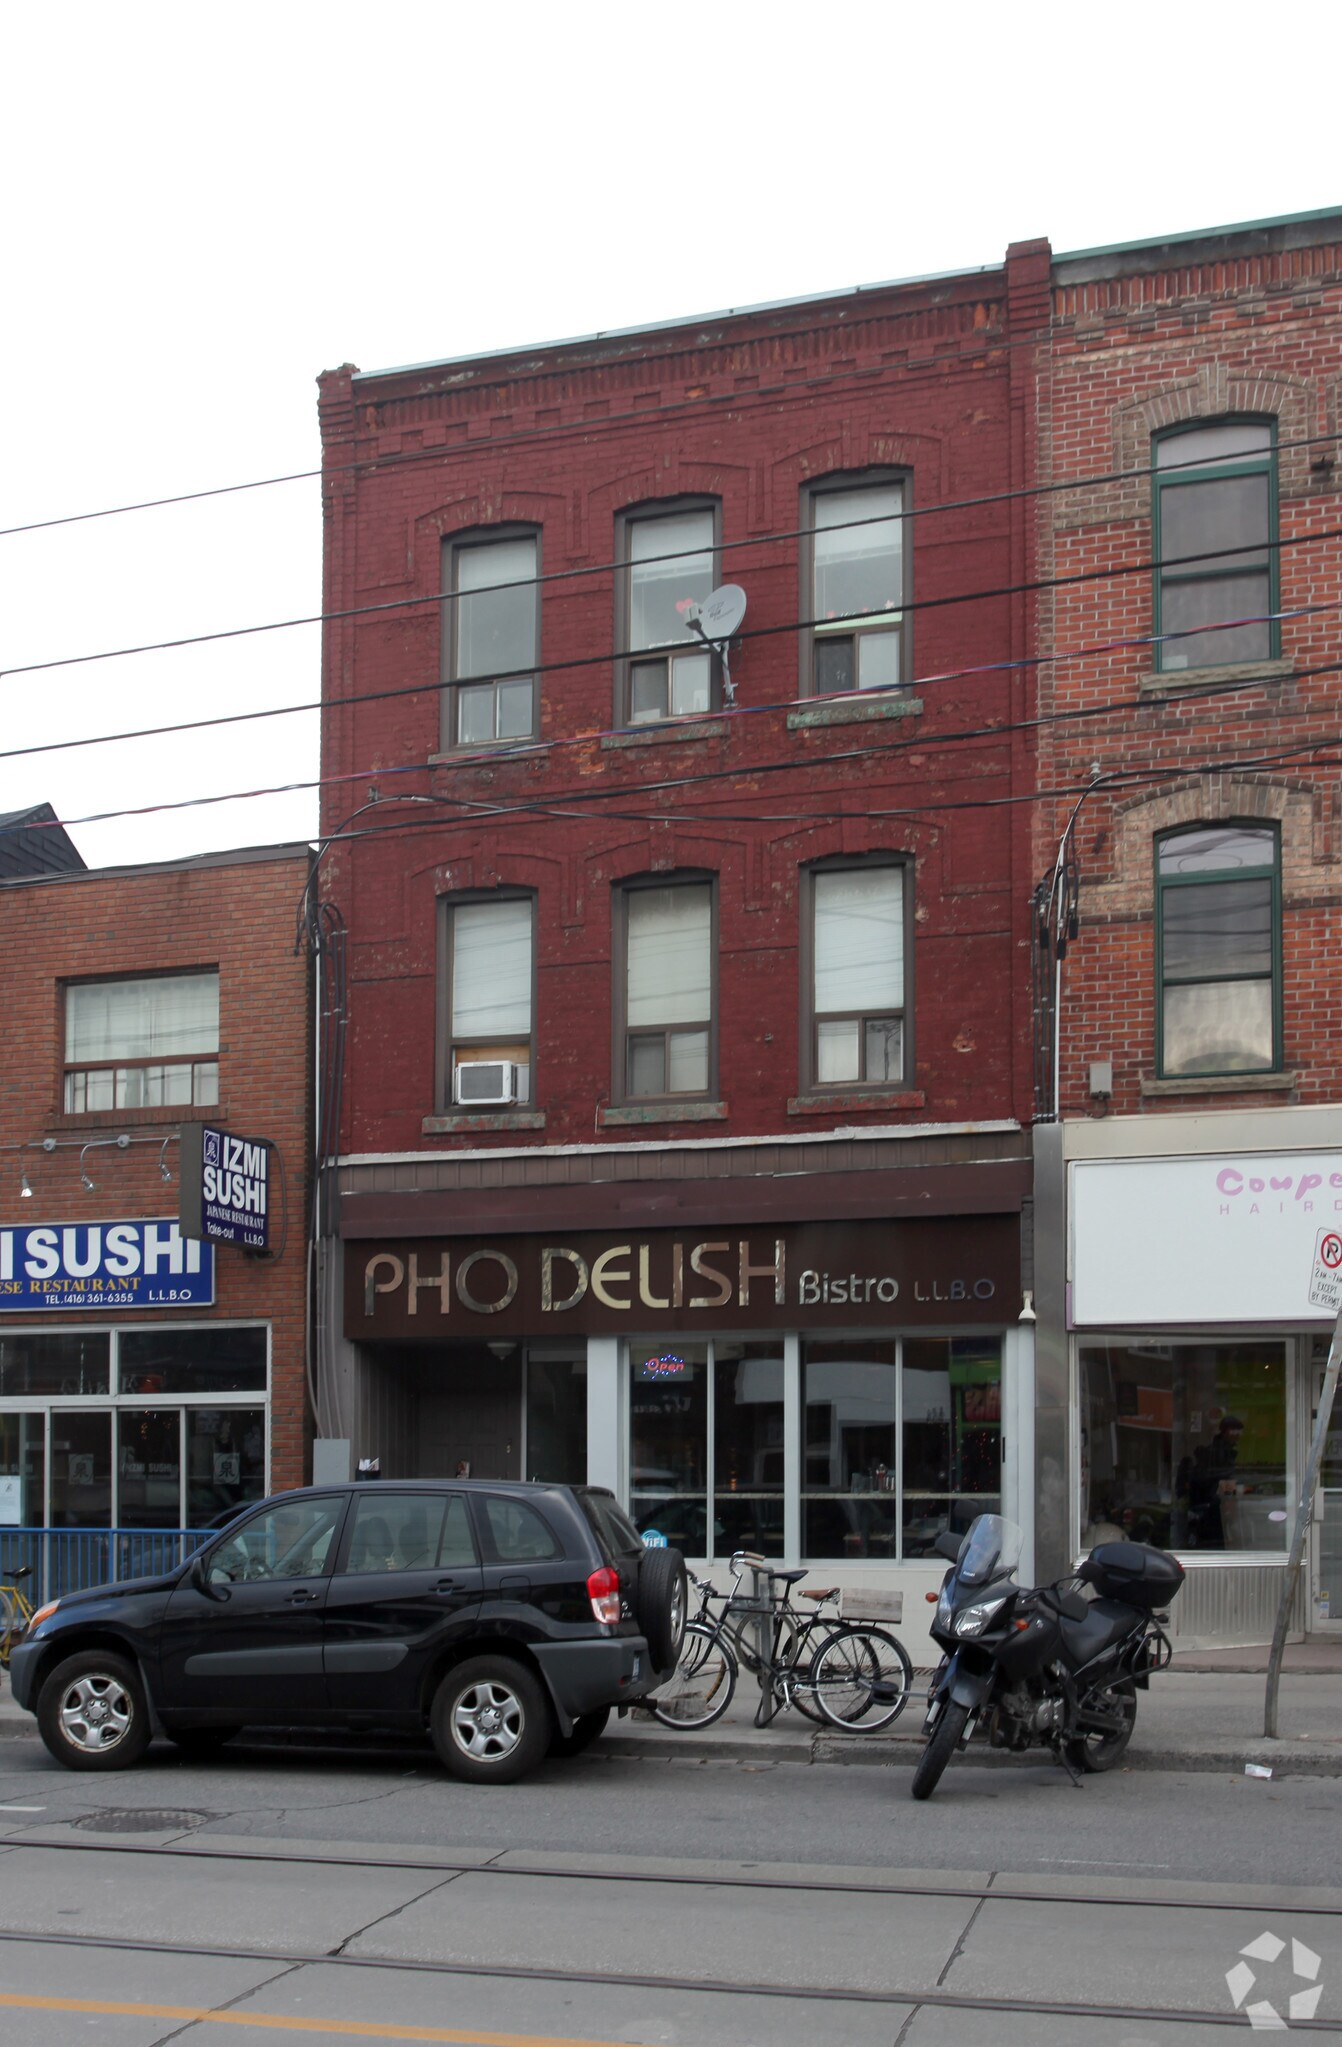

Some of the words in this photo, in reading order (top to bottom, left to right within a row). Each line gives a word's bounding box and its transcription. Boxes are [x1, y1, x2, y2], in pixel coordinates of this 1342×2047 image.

[223, 1135, 267, 1181] IZMI
[203, 1165, 267, 1215] SUSHI
[206, 1204, 231, 1222] JAPANESE
[231, 1210, 265, 1230] RESTAURANT
[207, 1221, 235, 1239] Take-out
[24, 1223, 201, 1280] SUSHI
[29, 1277, 142, 1294] RESTAURANT
[364, 1249, 519, 1316] PHO
[541, 1239, 786, 1312] DELISH
[799, 1269, 900, 1305] Bistro
[1317, 1281, 1338, 1295] EXCEPT
[87, 1292, 134, 1303] 361-6355
[1311, 1291, 1320, 1302] BY
[1320, 1293, 1340, 1308] PERMIT
[647, 1356, 685, 1373] Open
